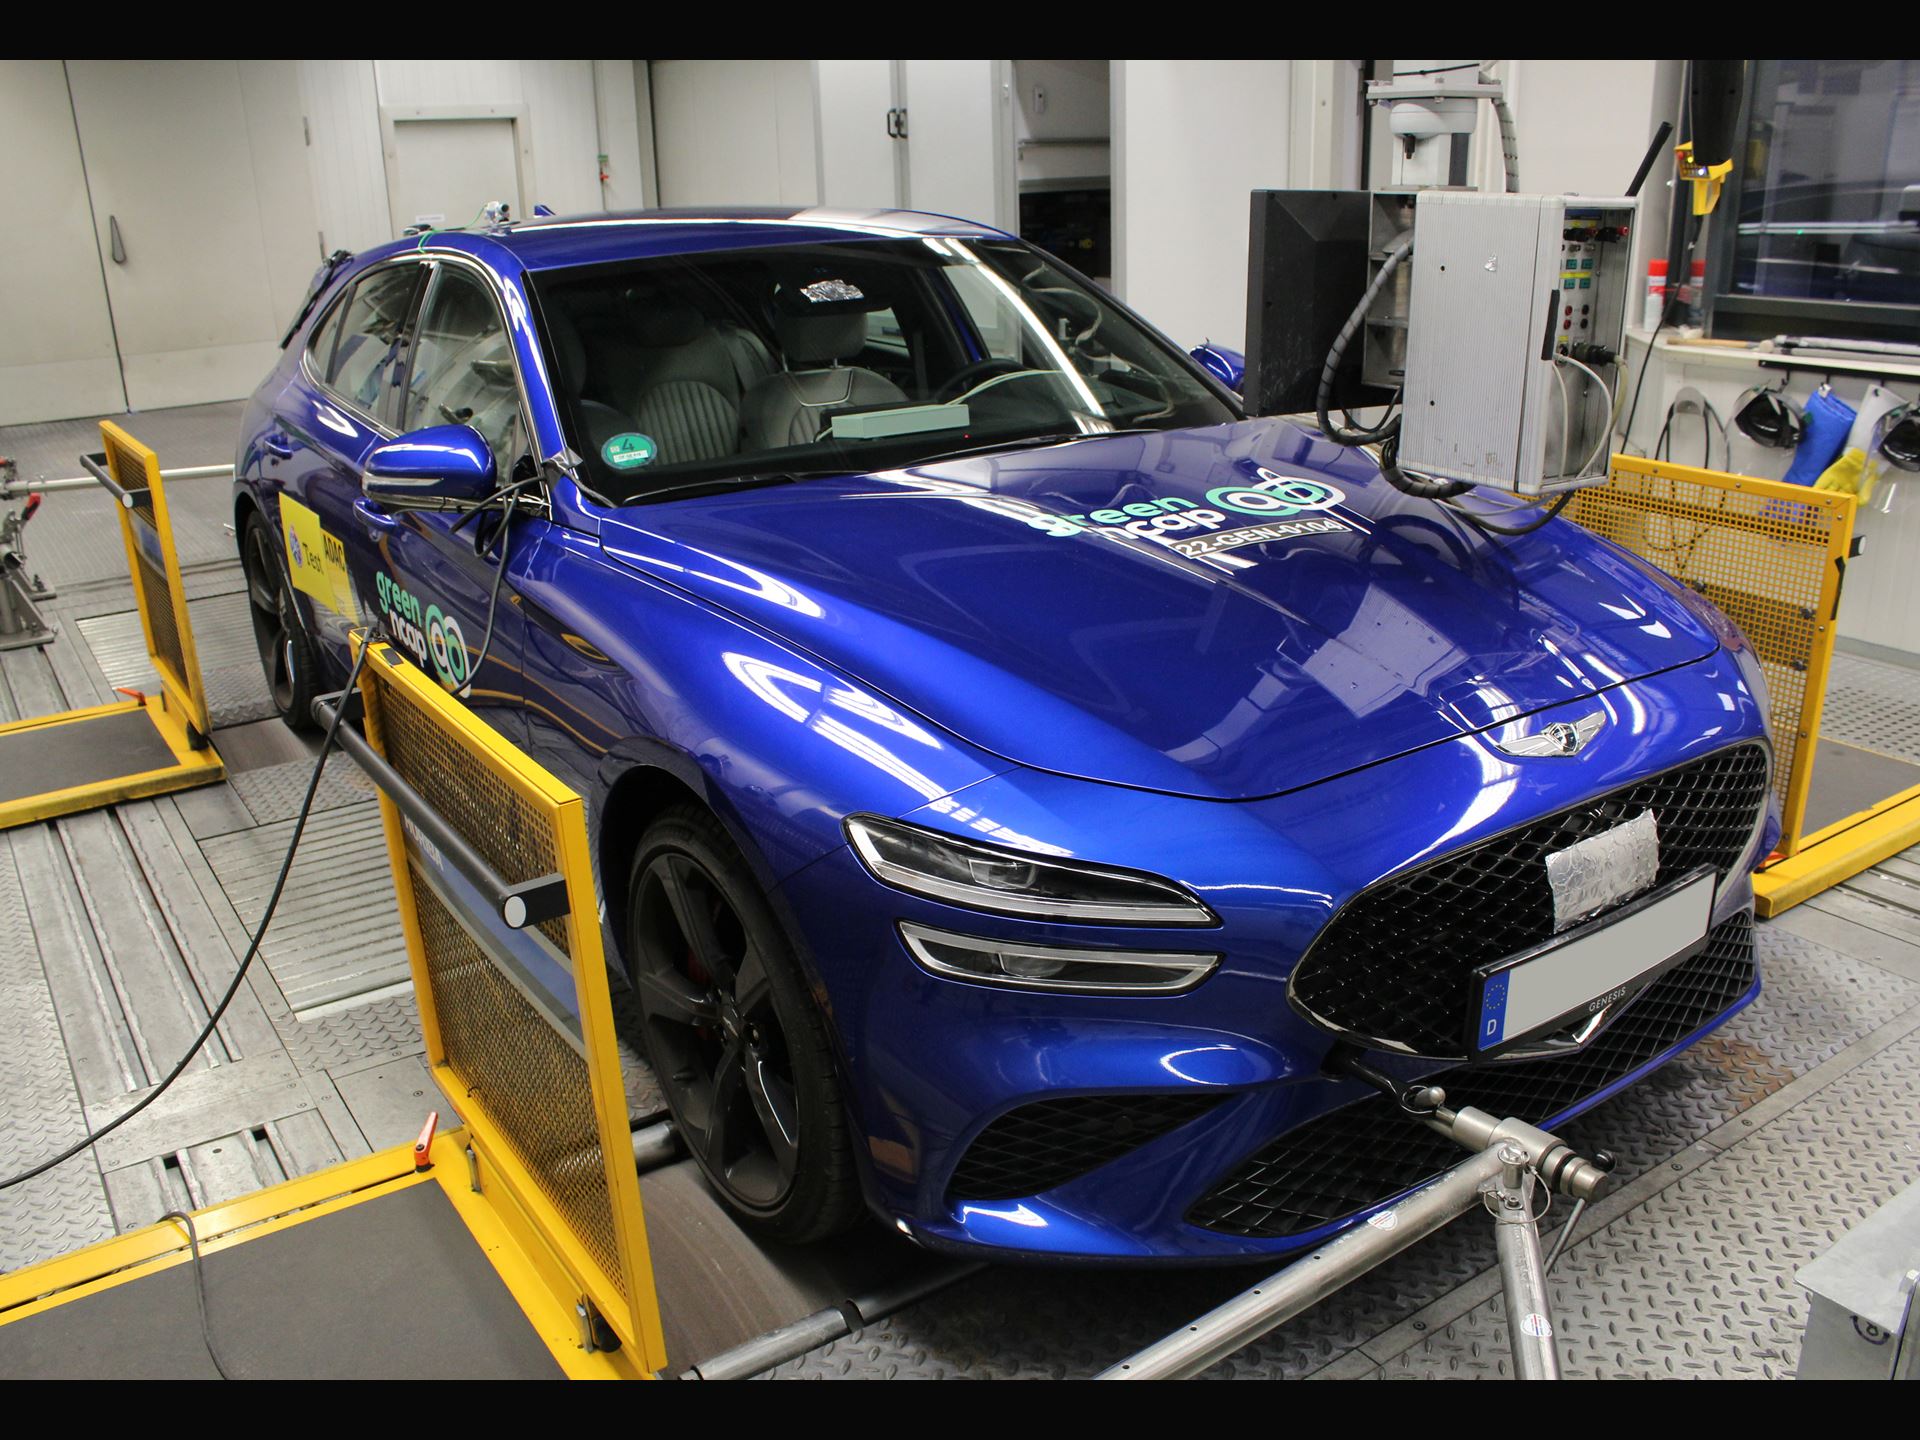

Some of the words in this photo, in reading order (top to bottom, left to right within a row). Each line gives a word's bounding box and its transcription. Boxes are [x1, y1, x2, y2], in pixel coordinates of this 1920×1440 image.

[622, 438, 635, 451] 4
[1027, 496, 1200, 537] green
[1089, 509, 1226, 540] ncap
[322, 534, 346, 573] ADAC
[1174, 518, 1344, 558] 22-GEN-0104
[302, 542, 325, 576] Test
[375, 571, 422, 627] green
[389, 610, 428, 668] ncap
[1588, 986, 1626, 1012] GENESIS
[1486, 1018, 1497, 1036] D
